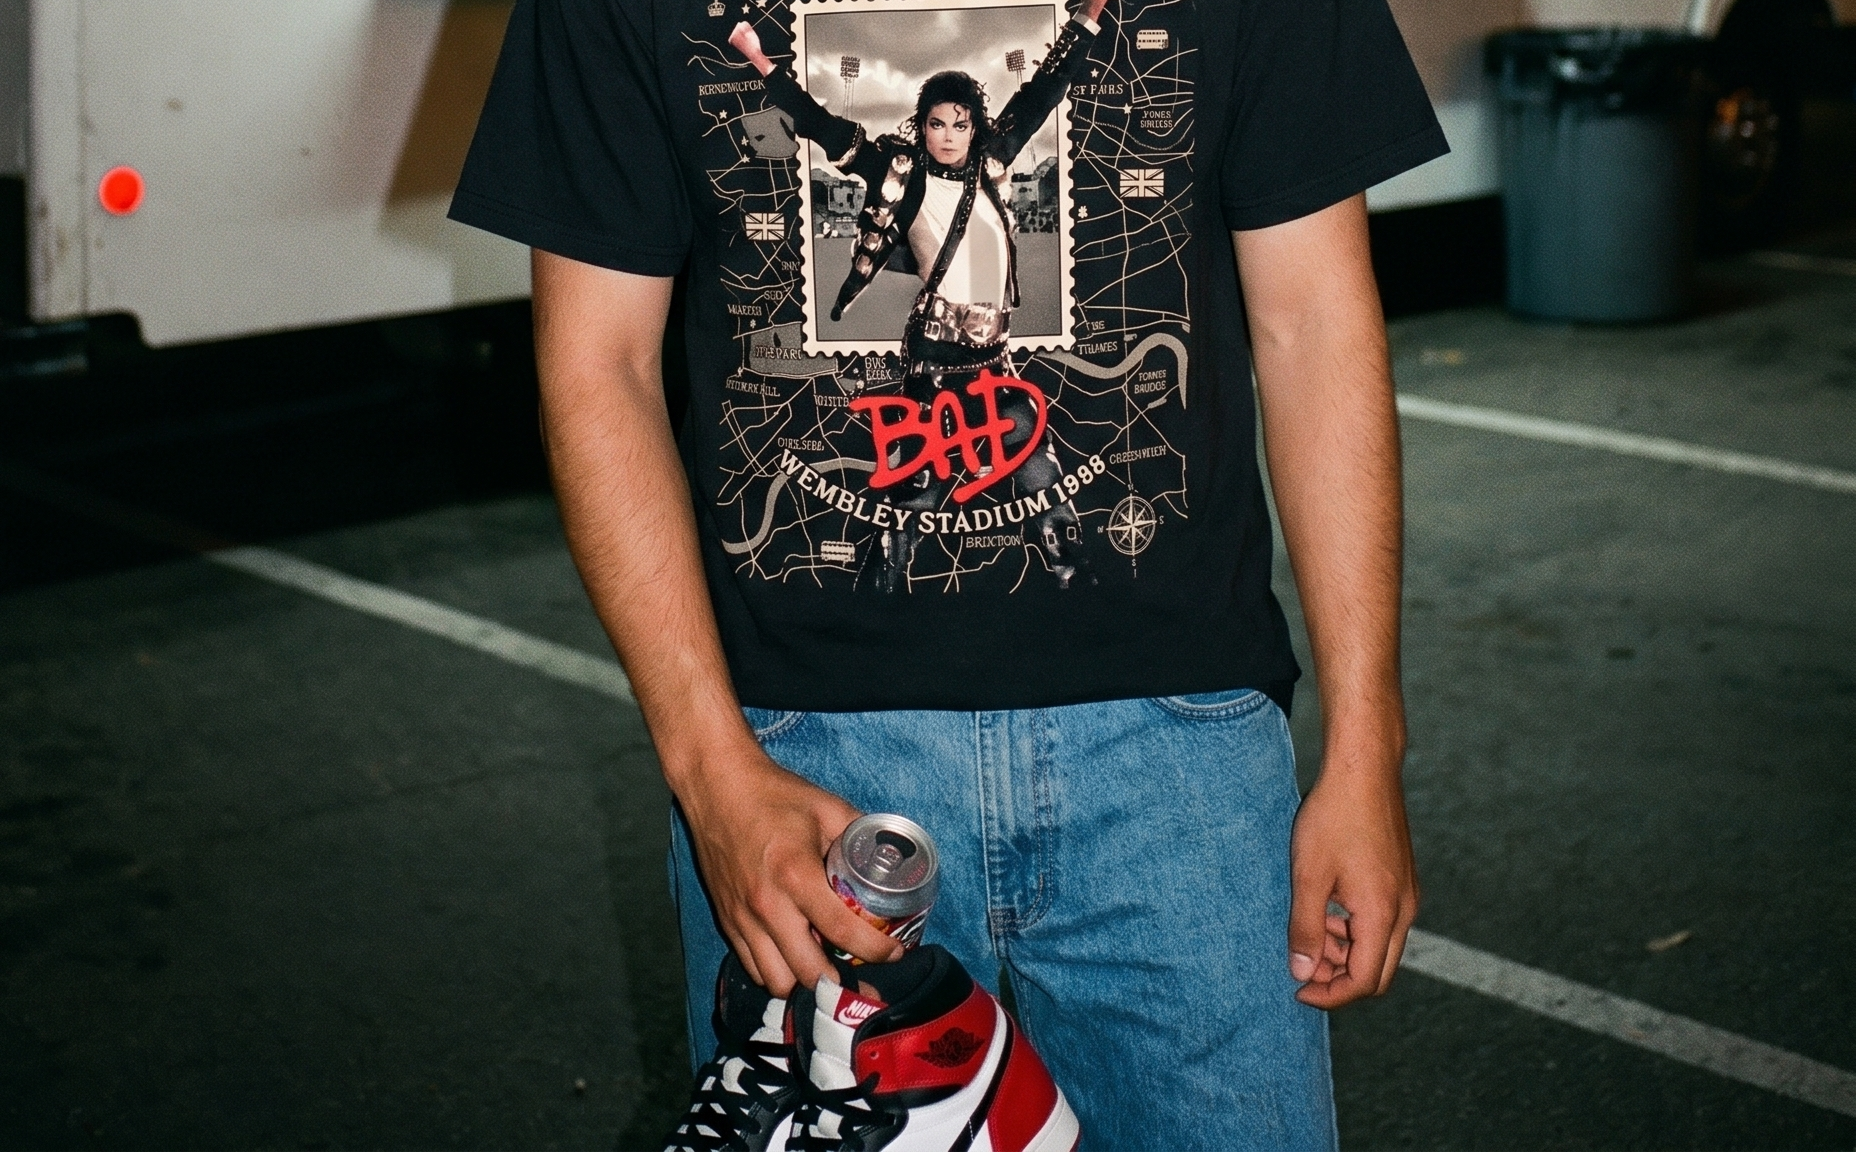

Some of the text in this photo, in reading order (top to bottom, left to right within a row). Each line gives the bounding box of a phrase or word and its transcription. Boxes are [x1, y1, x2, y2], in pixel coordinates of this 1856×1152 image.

[849, 368, 1047, 503] BAD
[779, 448, 912, 531] WEMBLEY
[918, 489, 1052, 534] STADIUM
